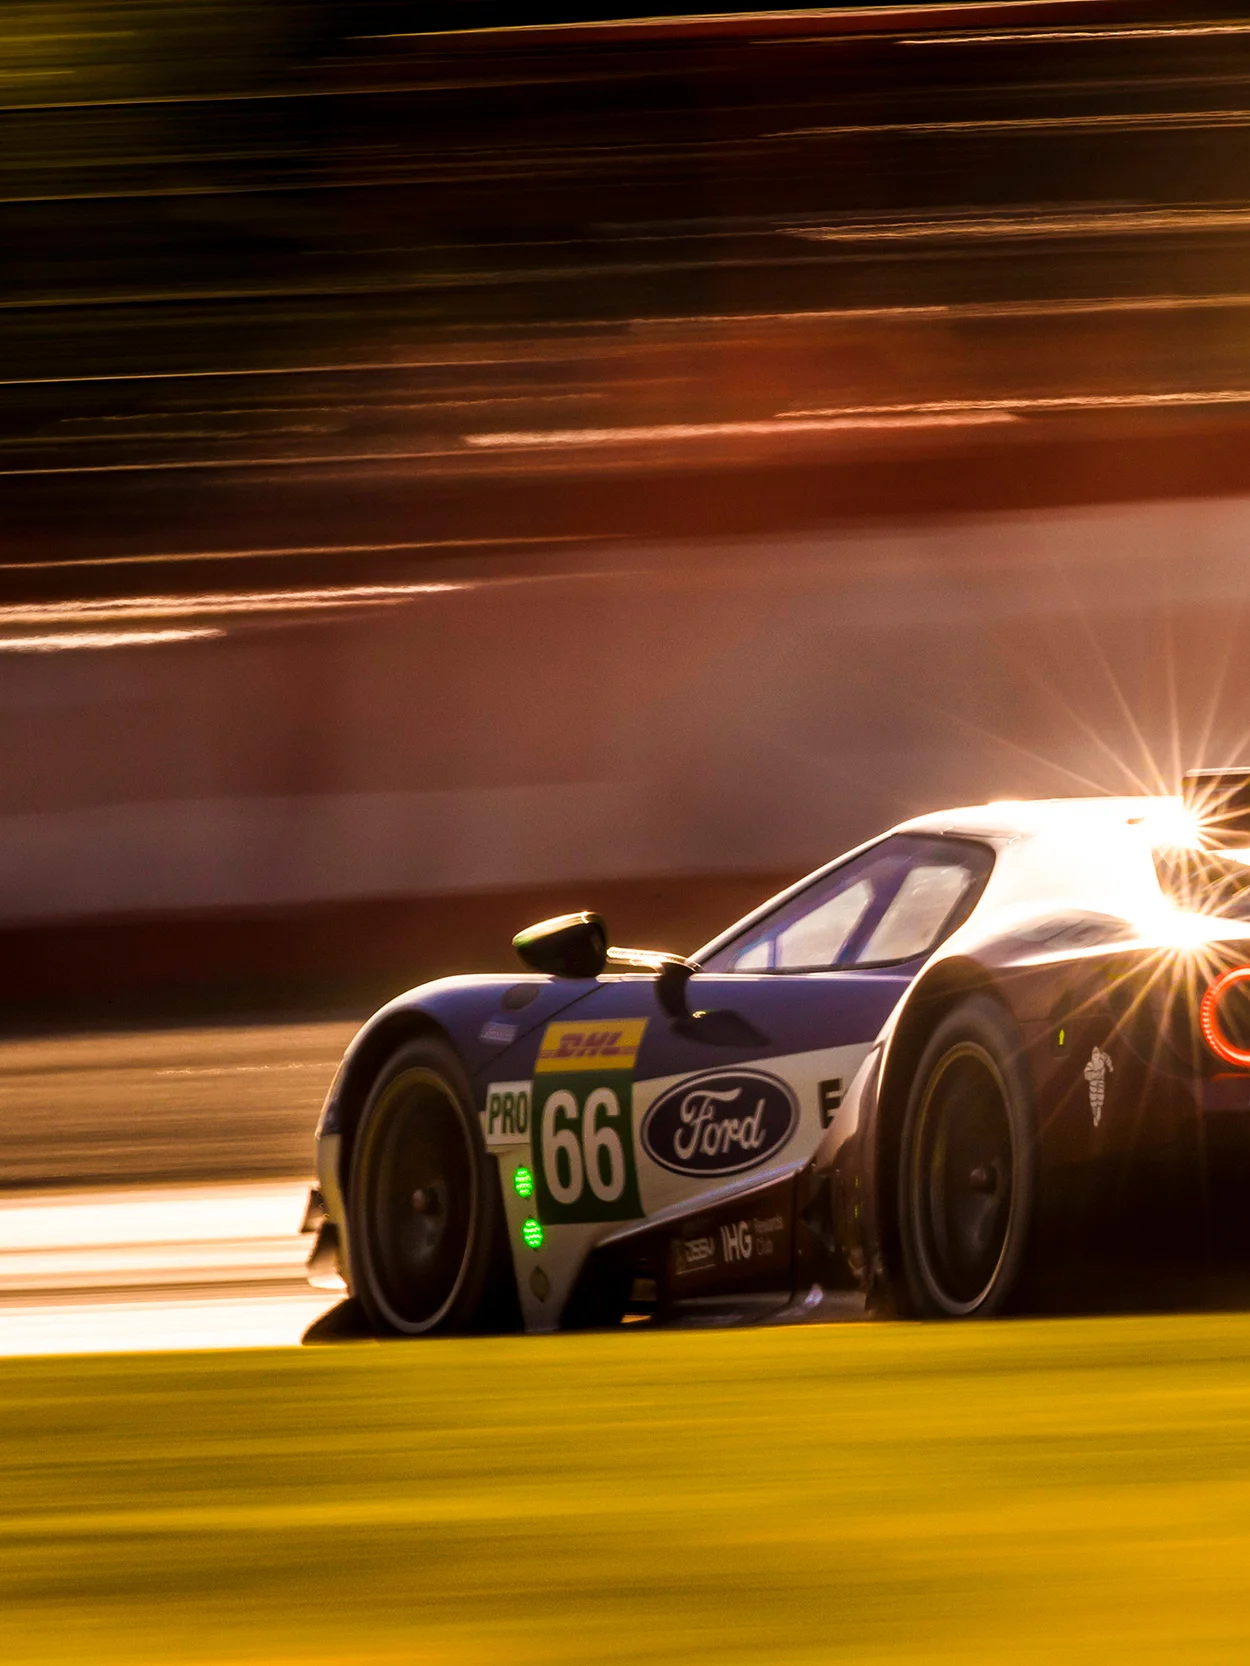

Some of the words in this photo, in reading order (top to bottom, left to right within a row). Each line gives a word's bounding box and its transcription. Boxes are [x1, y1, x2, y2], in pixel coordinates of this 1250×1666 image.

[556, 1030, 623, 1058] DHL
[488, 1090, 529, 1135] PRO
[673, 1087, 767, 1161] Ford
[541, 1087, 626, 1205] 66
[720, 1220, 753, 1263] IHG
